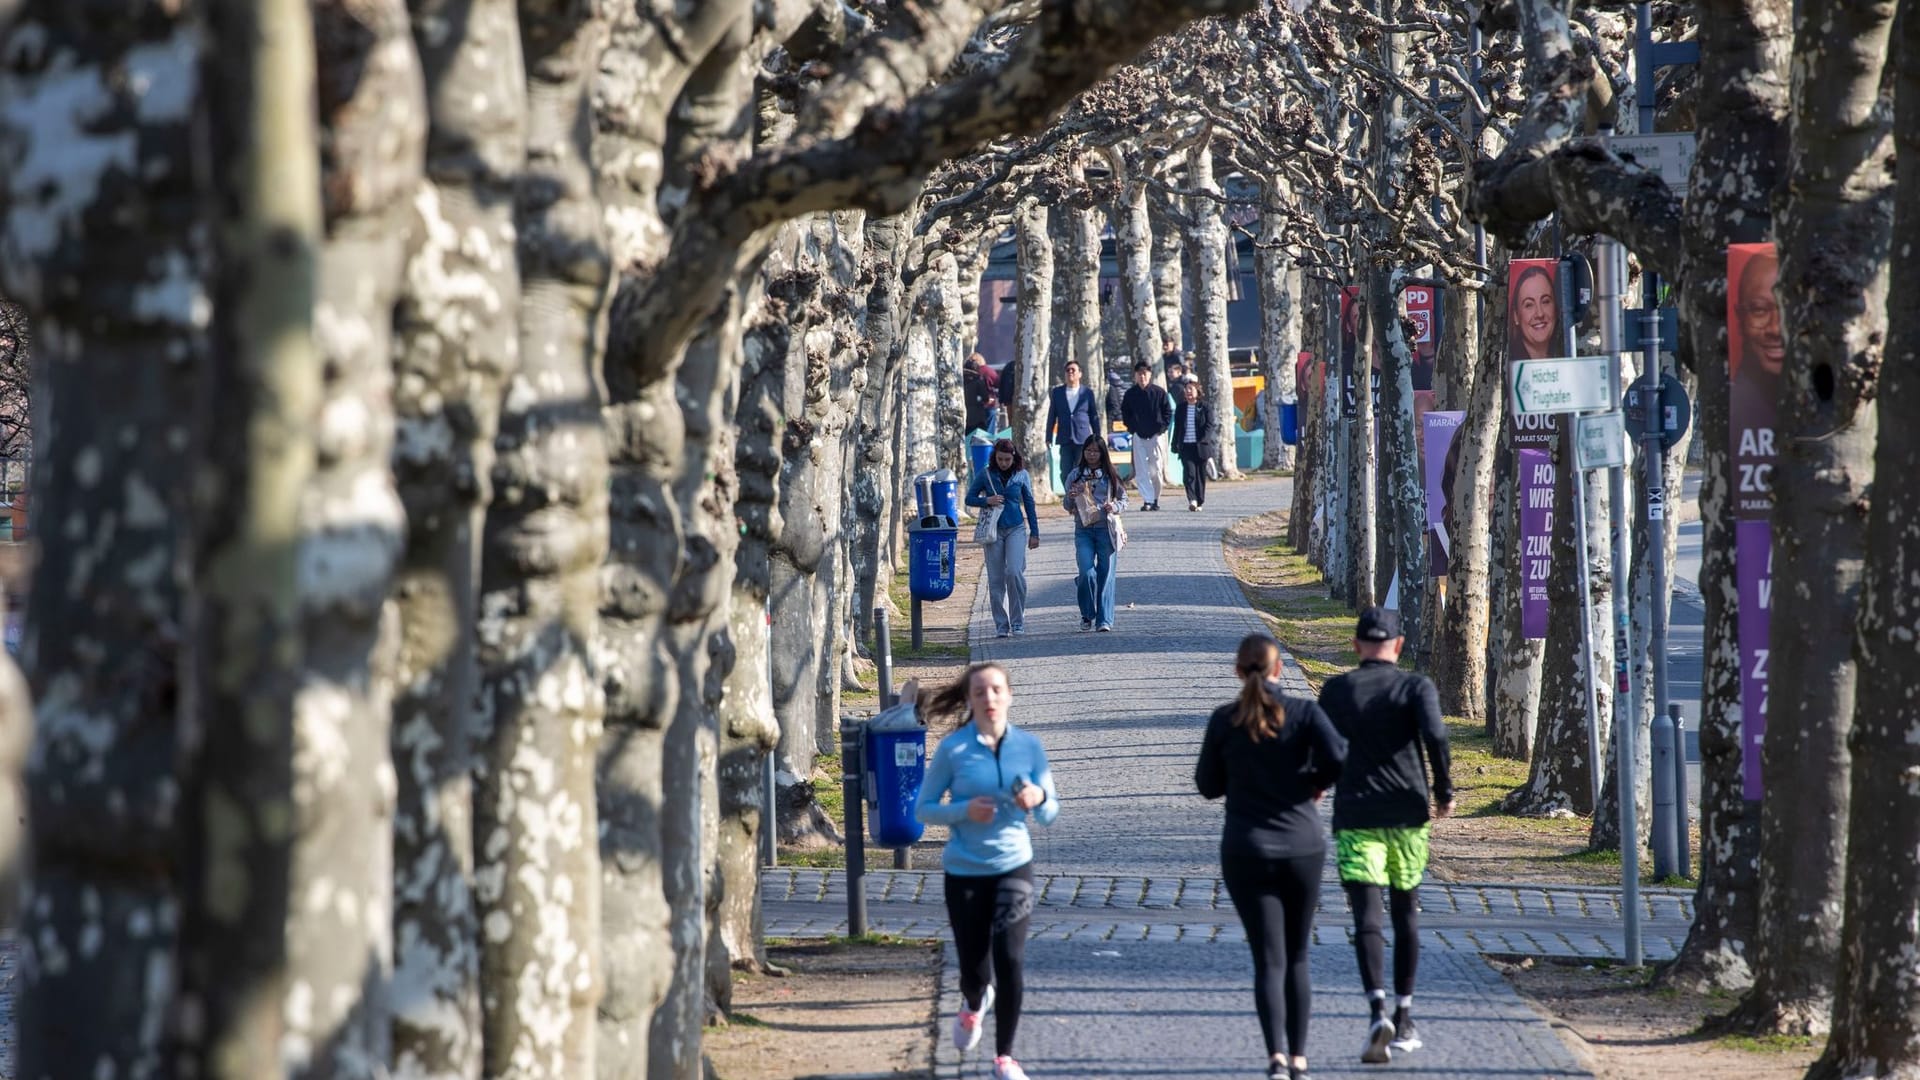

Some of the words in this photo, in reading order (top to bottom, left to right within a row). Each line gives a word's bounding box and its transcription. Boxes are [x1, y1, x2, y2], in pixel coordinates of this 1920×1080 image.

[1532, 368, 1559, 383] Höchst
[1533, 389, 1571, 408] Flughafen
[1429, 417, 1457, 428] MARAL
[1514, 435, 1535, 443] PLAKAT
[1739, 428, 1778, 456] AR
[1529, 487, 1554, 509] WIR
